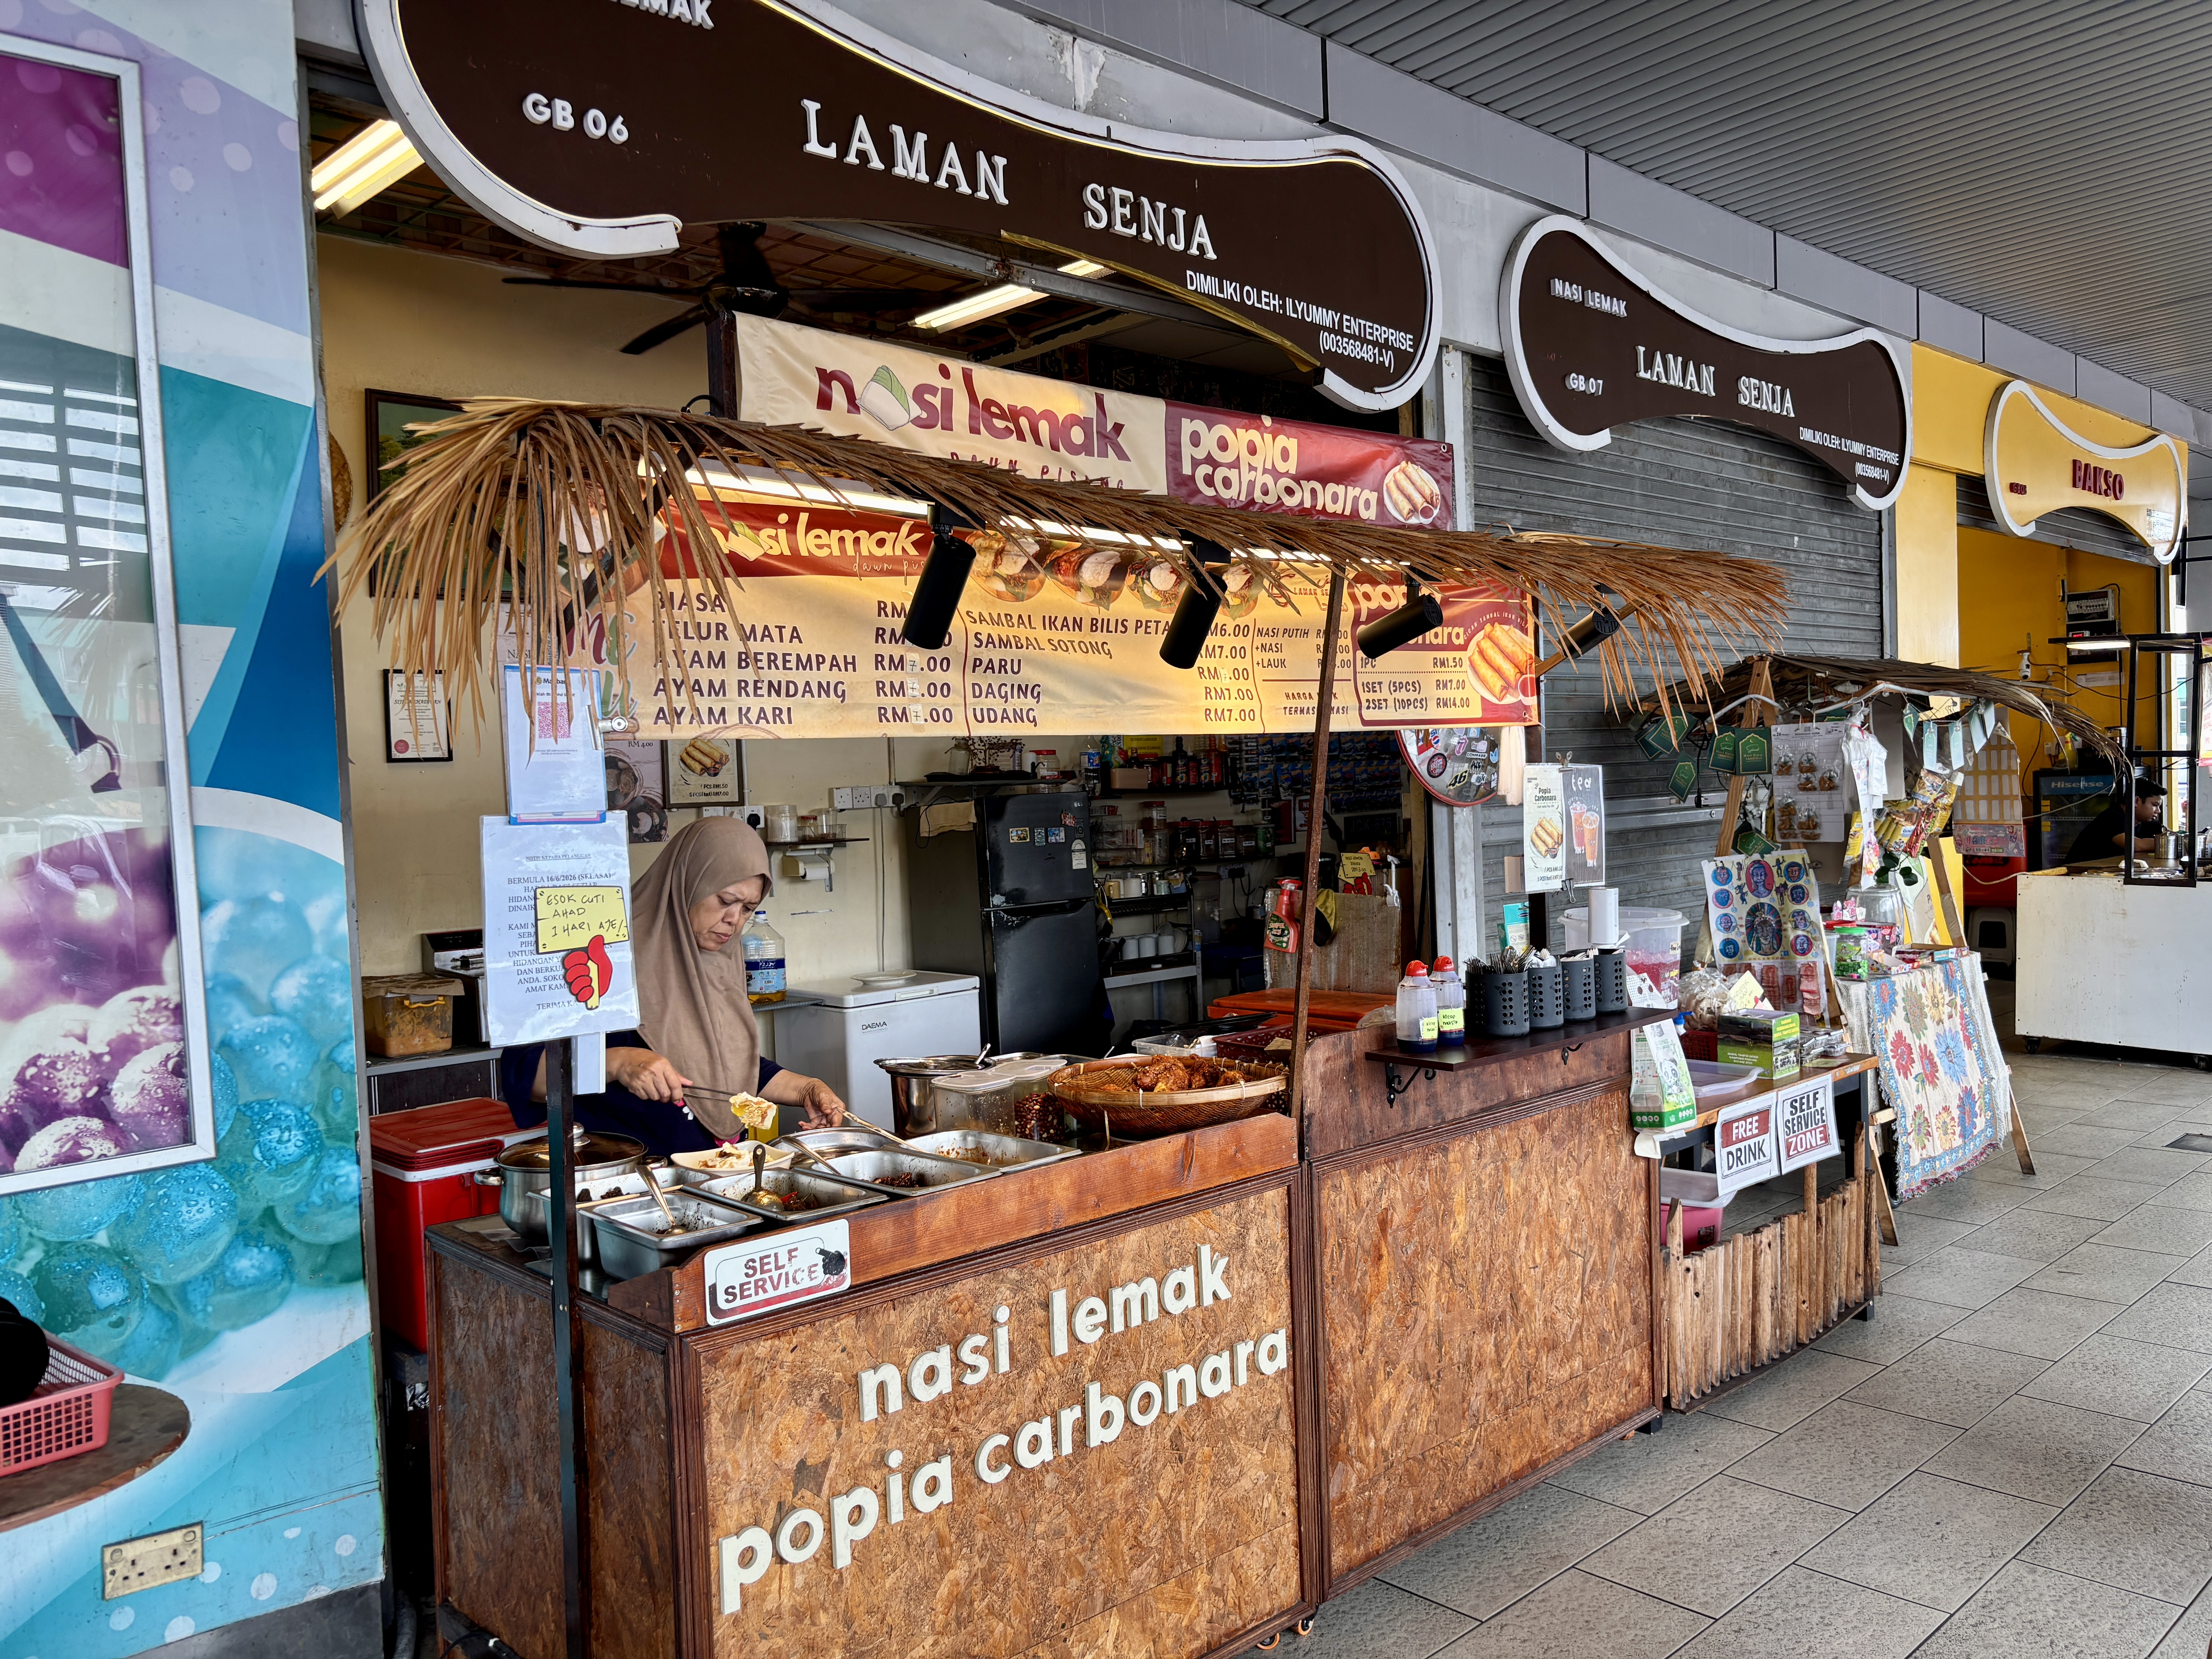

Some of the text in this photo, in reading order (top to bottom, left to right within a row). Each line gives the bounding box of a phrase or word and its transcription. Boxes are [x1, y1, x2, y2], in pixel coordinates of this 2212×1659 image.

[522, 93, 629, 145] GB 06
[801, 98, 1217, 260] LAMAN SENJA
[1551, 278, 1627, 318] NASI LEMAK
[1186, 270, 1414, 352] DIMILIKI OLEH: ILYUMMY ENTERPRISE
[1319, 330, 1394, 373] (003568481-V)
[1565, 373, 1603, 396] GB 07
[1636, 345, 1795, 418] LAMAN SENJA
[816, 364, 1132, 462] nsi lemak
[1181, 414, 1298, 476] popia
[1800, 427, 1899, 465] DIMILIKI OLEH: ILYUMMY ENTERPRISE
[1855, 462, 1889, 484] (003568481-V)
[2073, 459, 2124, 500] BAKSO
[1195, 464, 1378, 520] carbonara
[797, 513, 925, 557] lemak
[966, 611, 1250, 638] SAMBAL IKAN BILIS PETA M6.00
[1479, 611, 1500, 623] SAMBAL
[1503, 611, 1515, 620] IKAN
[740, 623, 803, 644] MATA
[1257, 627, 1310, 639] NASI PUTIH
[508, 649, 531, 658] NSI
[974, 632, 1046, 651] SAMBAL
[1048, 639, 1113, 659] SOTONG
[1255, 643, 1283, 653] +NASI
[738, 651, 857, 672] BEREMPAH
[875, 653, 950, 672] RM7.00
[972, 658, 1022, 675] PARU
[1256, 658, 1287, 669] +LAUK
[1360, 656, 1463, 669] 1PC RM1.50
[653, 678, 846, 704] AYAM RENDANG
[876, 680, 951, 698] RM7.00
[972, 683, 1253, 704] DAGING RM7.00
[1285, 692, 1314, 701] HARGA
[1362, 679, 1466, 695] 1SET (5PCS) RM7.00
[1283, 706, 1316, 716] TERMAS
[1365, 696, 1470, 712] 2SET (10PCS) RM14.00
[653, 706, 793, 725] AYAM KARI
[878, 706, 953, 723] RM7.00
[973, 708, 1255, 727] UDANG RM7.00
[1448, 770, 1468, 788] 46
[1571, 774, 1592, 792] tea
[1534, 794, 1556, 802] Carbonara
[1375, 817, 1392, 830] 675
[508, 876, 545, 884] BERMULA
[546, 874, 577, 883] 16/6/2026
[547, 894, 577, 905] ESOK
[553, 907, 586, 919] AHAD
[508, 922, 531, 930] KAMI
[563, 922, 591, 937] HARI
[508, 948, 536, 958] UNTUK
[514, 957, 554, 967] HIDANGAN
[518, 977, 542, 985] ANDA.
[526, 985, 547, 993] AMAT
[537, 1001, 566, 1010] TERIMA
[862, 1021, 887, 1030] DAEMA
[1790, 1091, 1819, 1116] SELF
[1733, 1116, 1759, 1141] FREE
[1785, 1106, 1826, 1137] SERVICE
[1788, 1127, 1826, 1156] ZONE
[1726, 1139, 1766, 1171] DRINK
[744, 1247, 799, 1278] SELF
[724, 1263, 819, 1304] SERVICE
[858, 1243, 1231, 1422] nasi lemak
[718, 1328, 1288, 1615] popia carbonara
